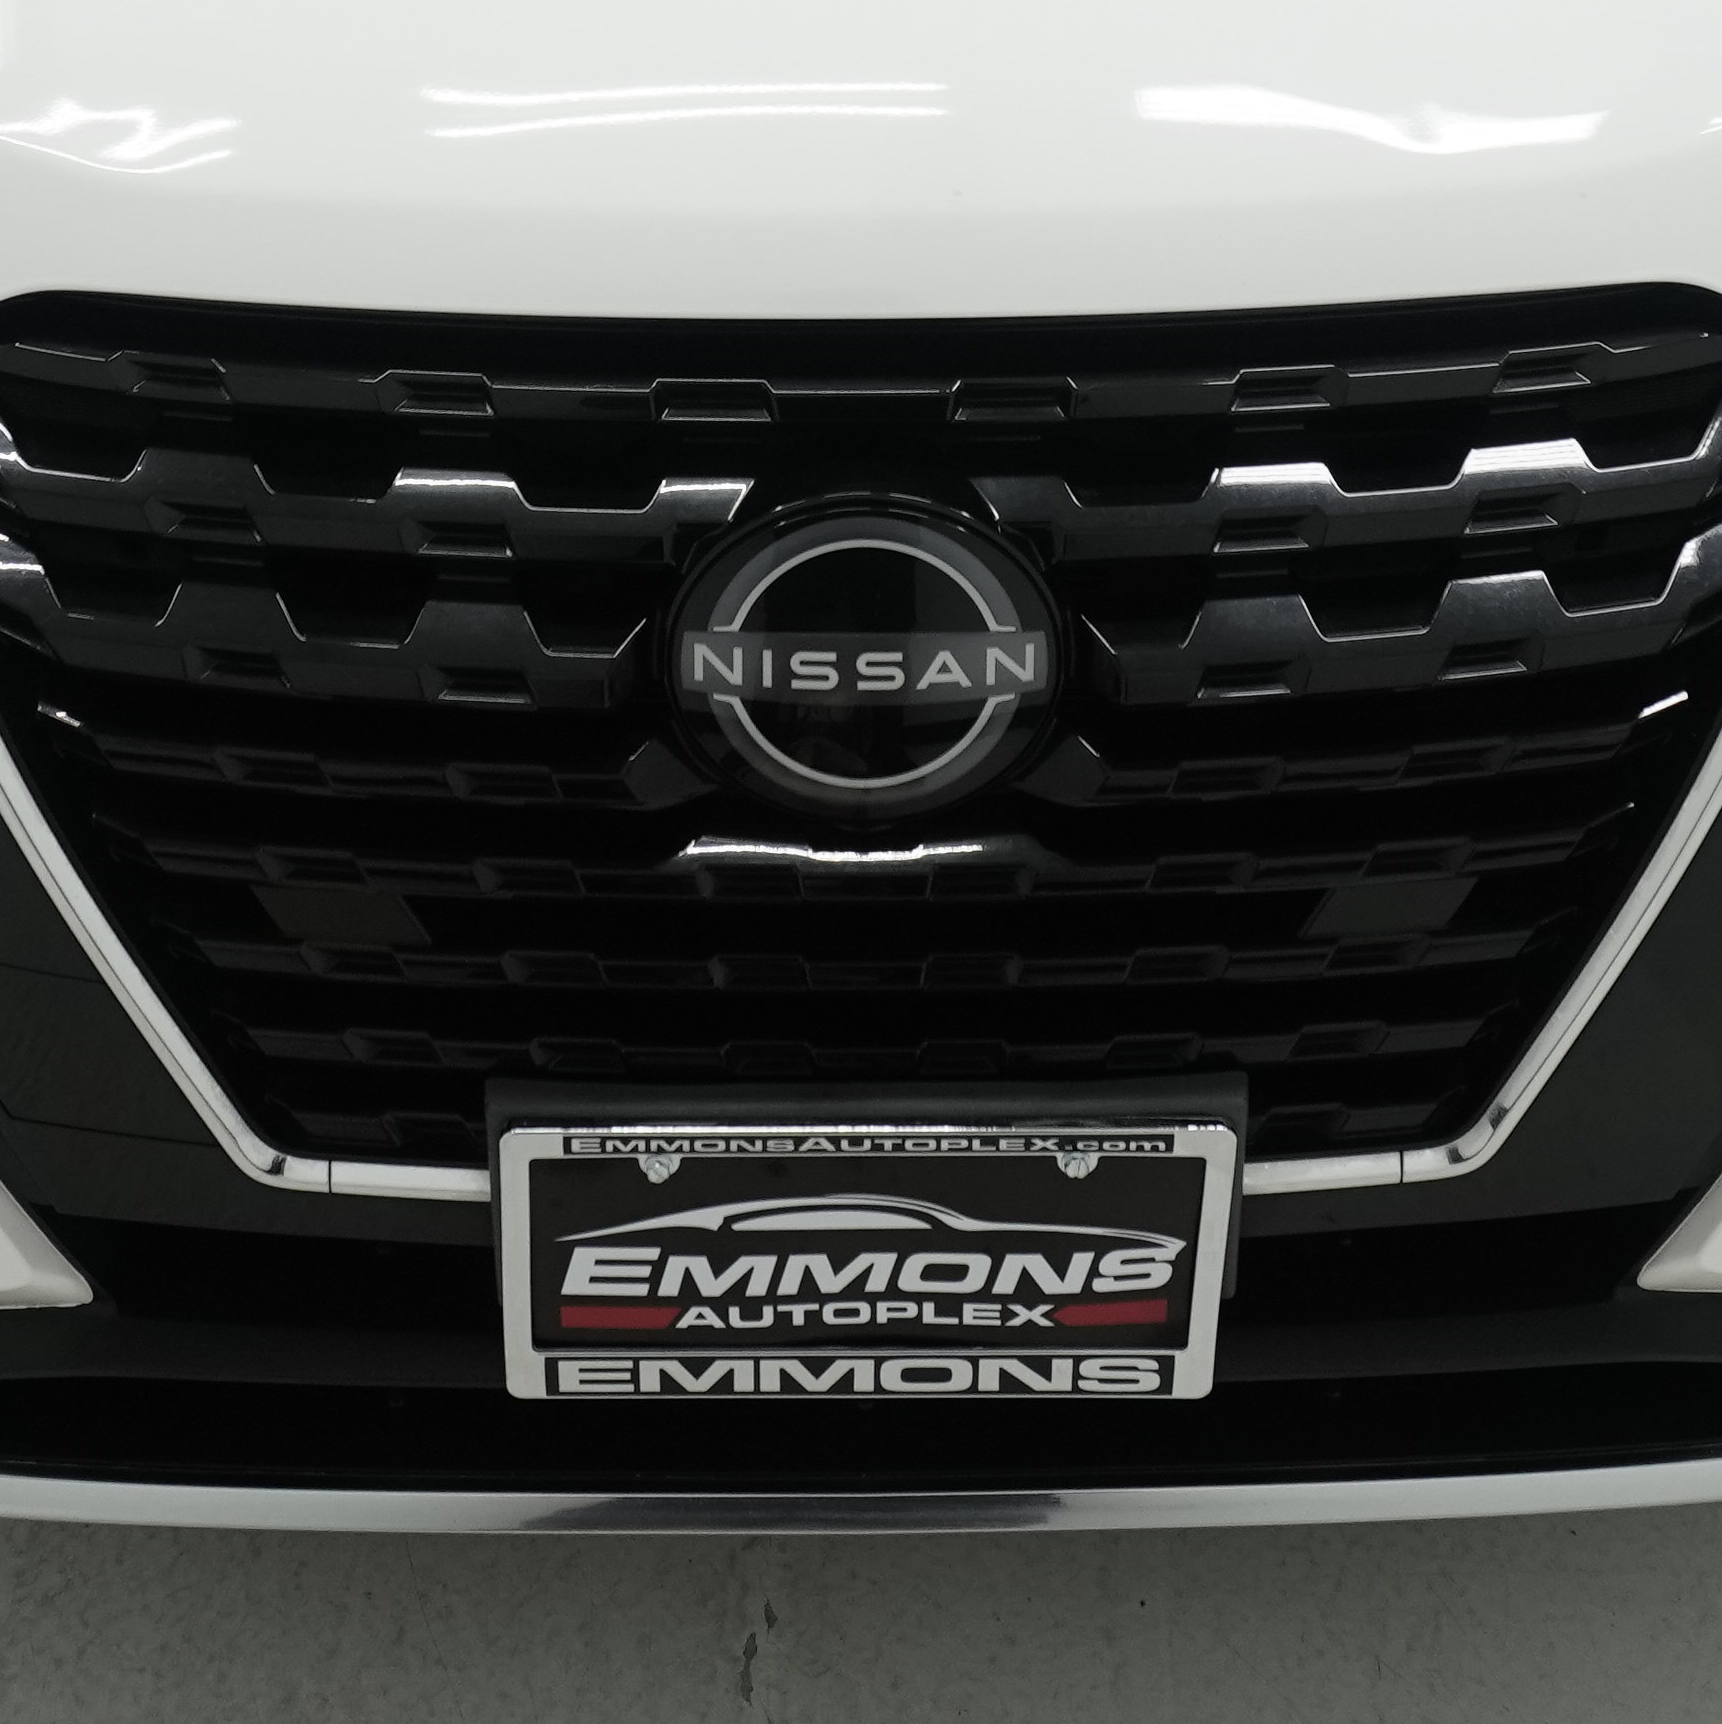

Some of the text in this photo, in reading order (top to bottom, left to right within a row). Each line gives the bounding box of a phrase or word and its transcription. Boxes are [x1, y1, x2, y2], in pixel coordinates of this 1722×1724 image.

[693, 643, 1035, 691] NISSAN
[561, 1246, 1182, 1297] EMMONS
[675, 1301, 1055, 1329] AUTOPLEX
[557, 1358, 1162, 1393] EMMONS
